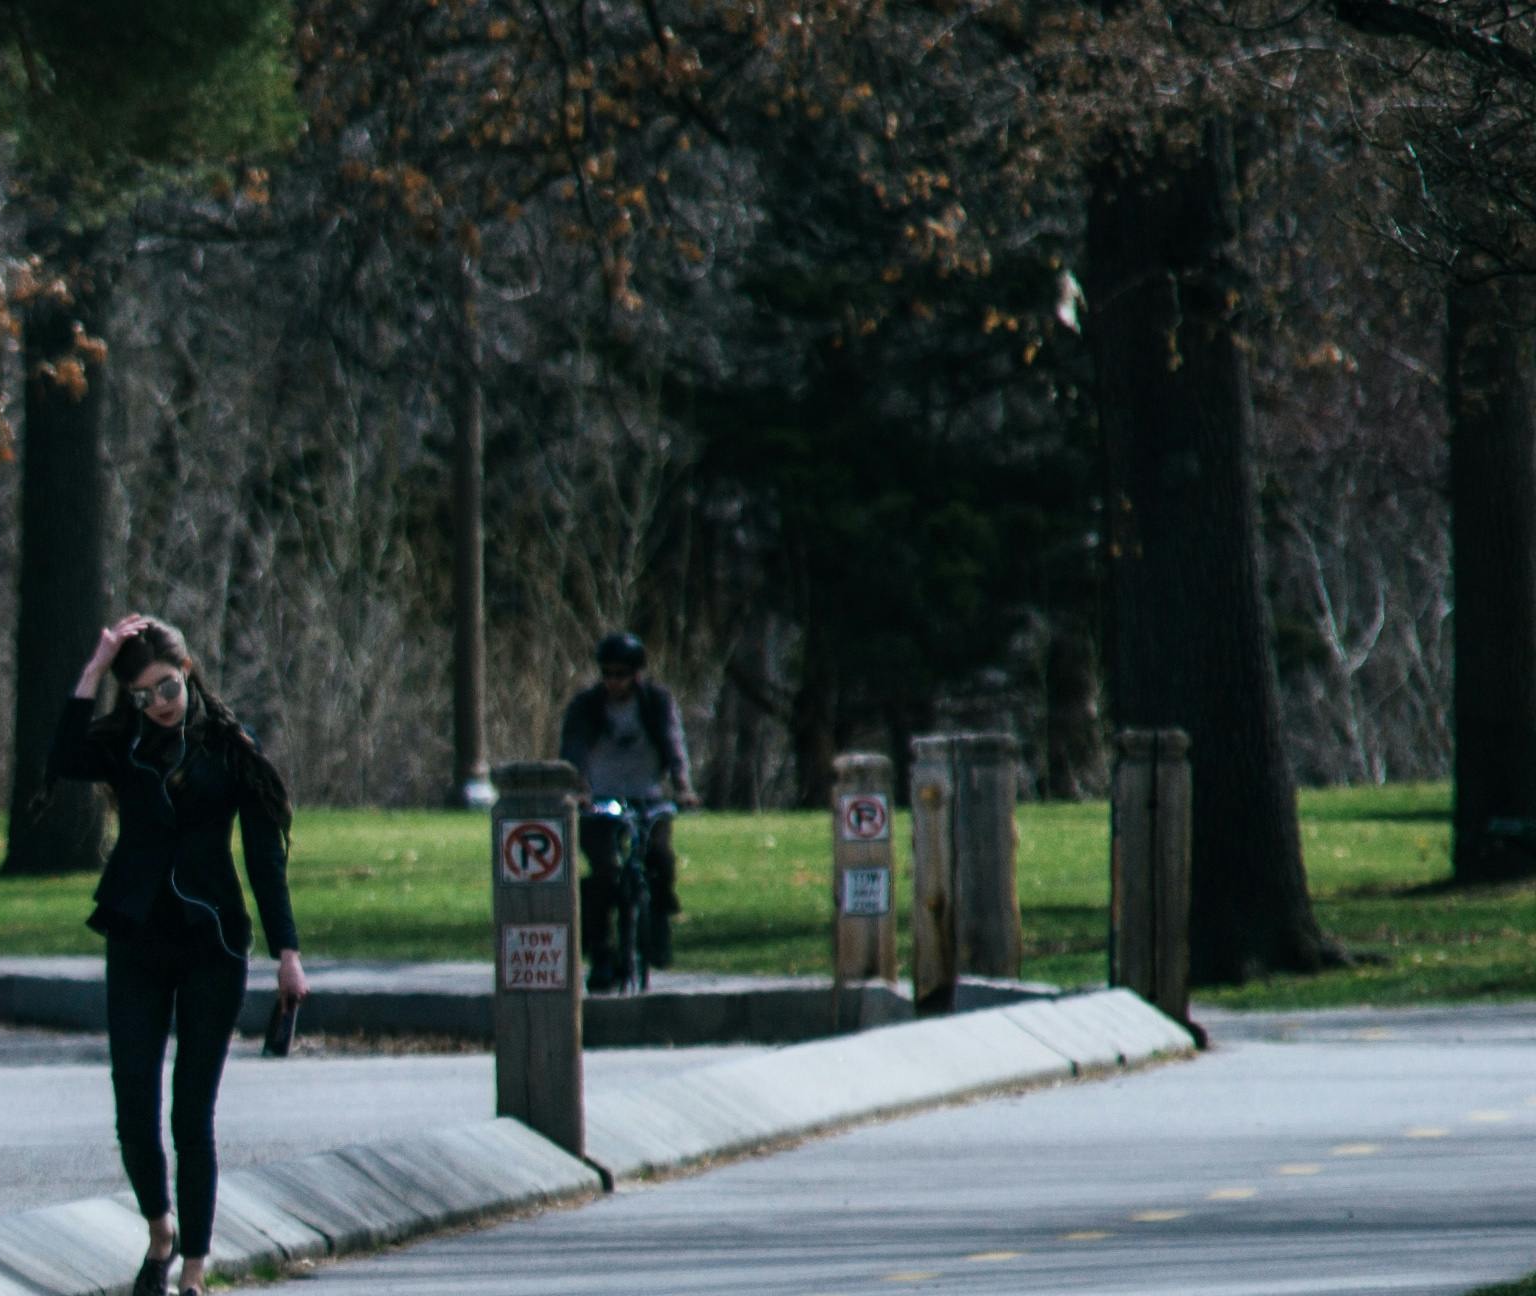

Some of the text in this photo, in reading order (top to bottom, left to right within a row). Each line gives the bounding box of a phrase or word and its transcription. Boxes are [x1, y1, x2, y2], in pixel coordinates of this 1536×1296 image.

[519, 931, 553, 946] TOW
[511, 951, 562, 965] AWAY
[511, 970, 562, 985] ZONE
